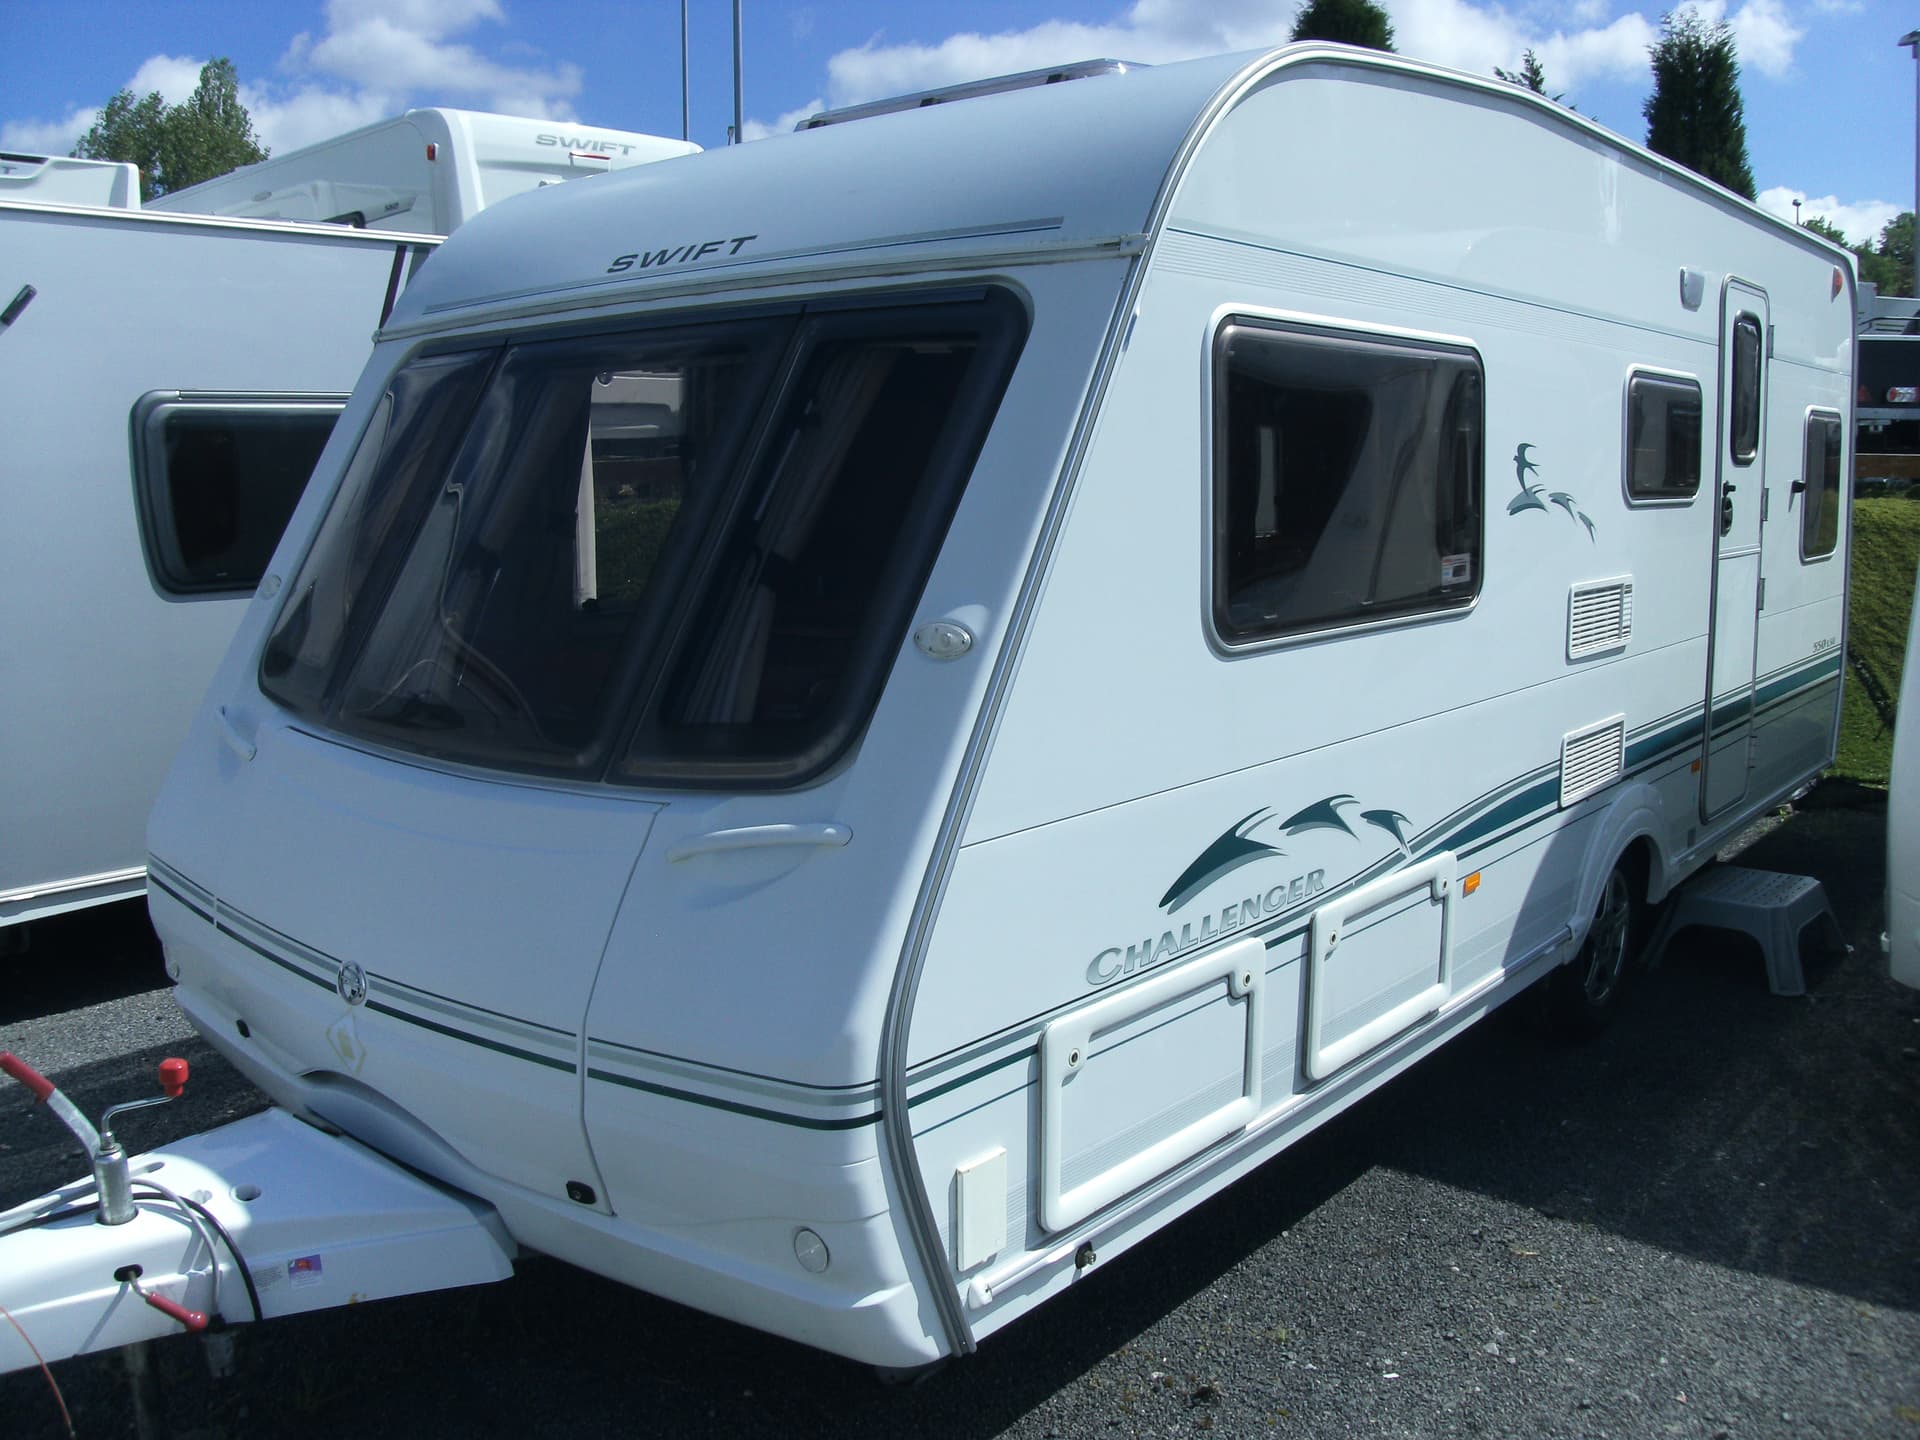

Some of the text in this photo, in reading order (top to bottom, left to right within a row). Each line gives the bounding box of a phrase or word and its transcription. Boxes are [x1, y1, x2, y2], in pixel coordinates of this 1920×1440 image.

[535, 133, 637, 156] SWIFT
[606, 234, 759, 274] SWIFT
[1085, 867, 1326, 986] CHALLENGER
